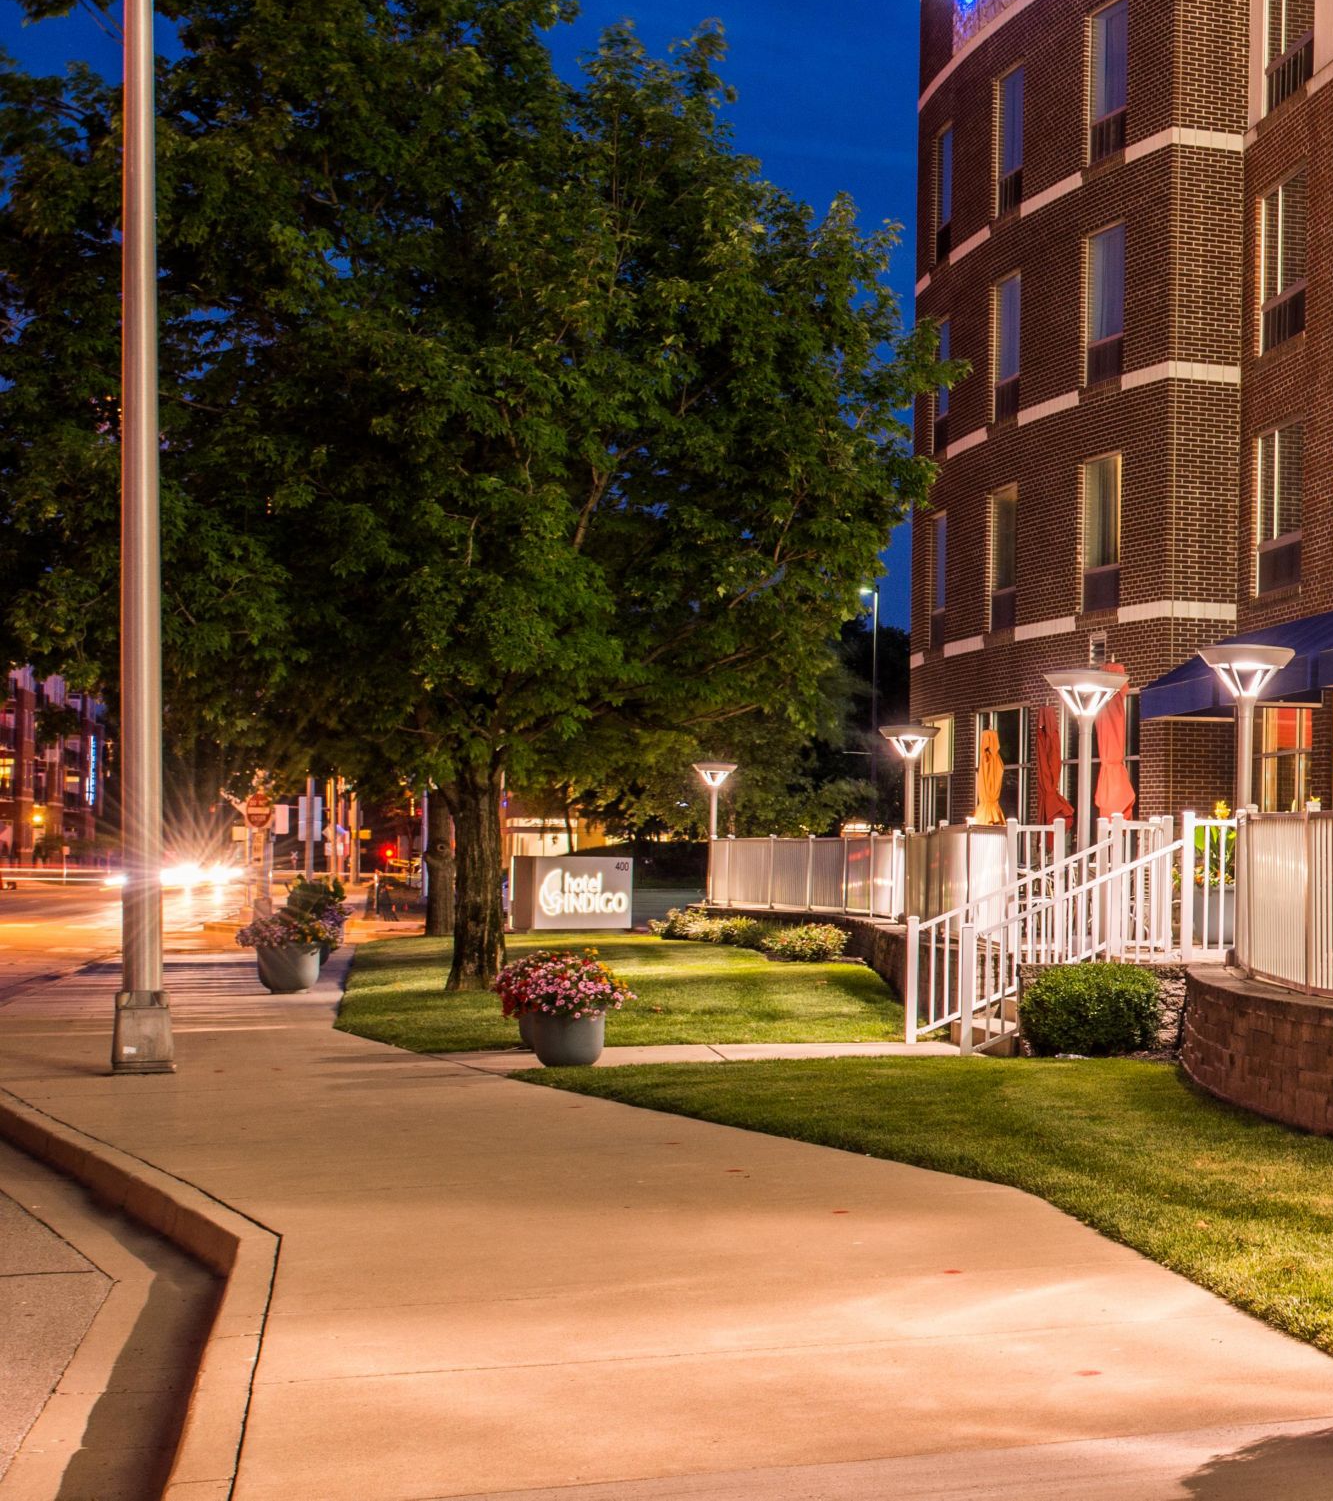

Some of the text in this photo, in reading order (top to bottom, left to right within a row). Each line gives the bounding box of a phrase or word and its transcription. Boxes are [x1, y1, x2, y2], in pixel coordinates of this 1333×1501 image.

[615, 862, 629, 871] 400
[564, 871, 602, 893] hotel
[564, 892, 628, 913] INDIGO
